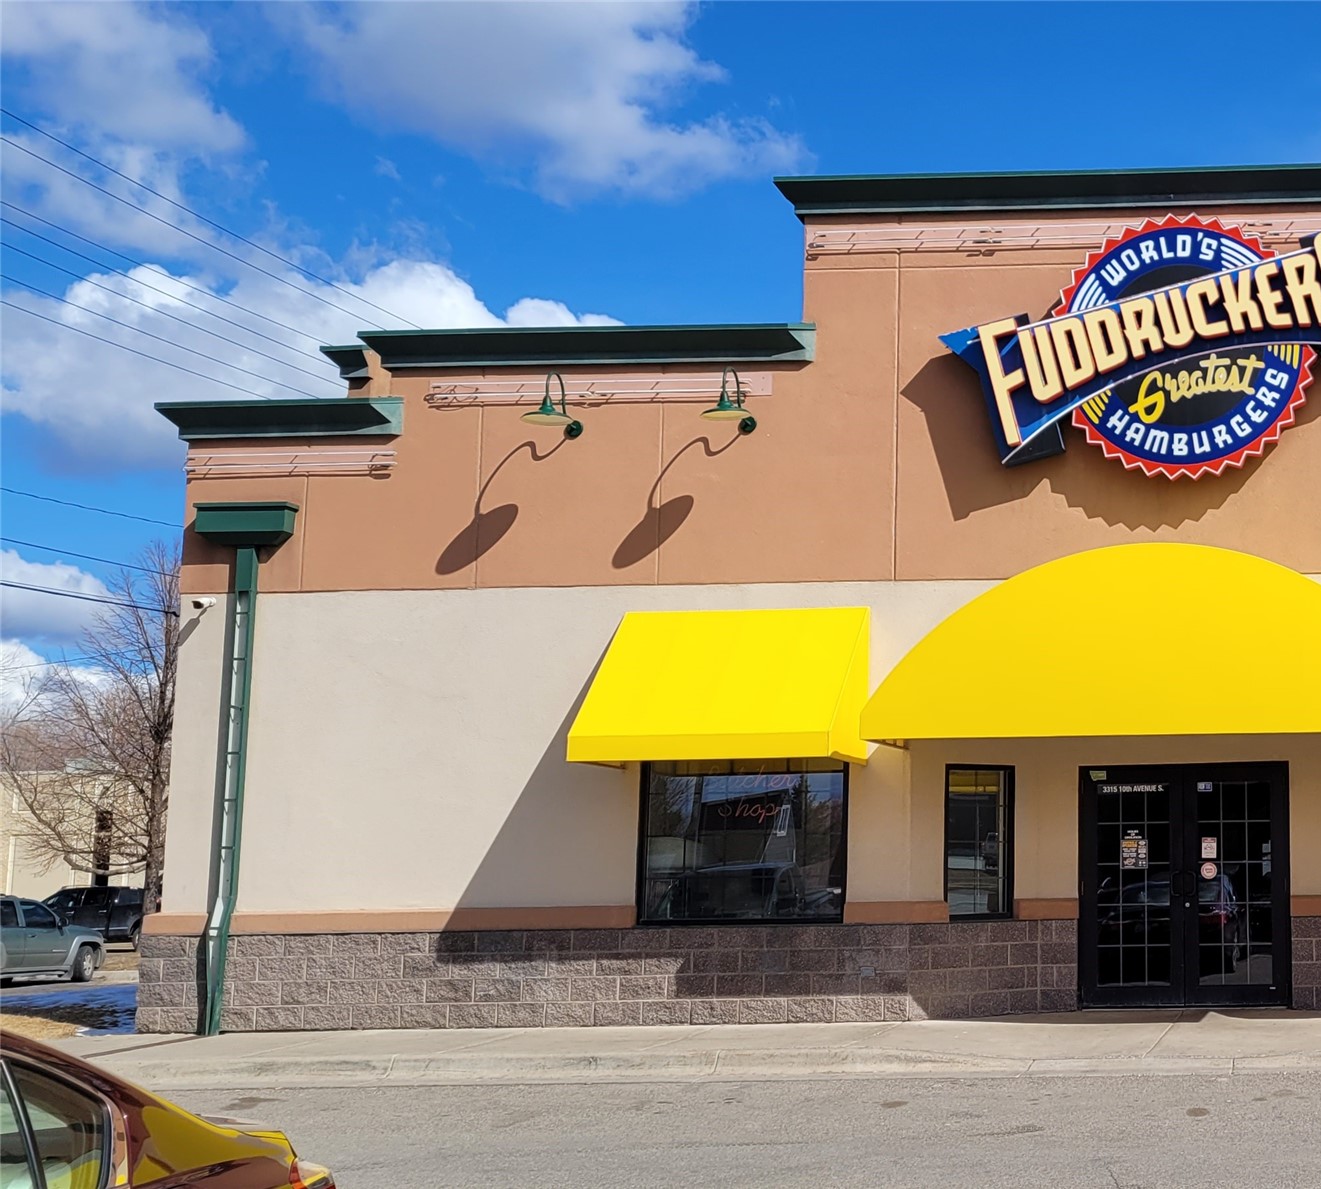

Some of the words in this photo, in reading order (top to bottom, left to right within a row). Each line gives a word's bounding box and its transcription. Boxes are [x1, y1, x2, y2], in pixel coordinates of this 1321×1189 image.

[1101, 232, 1218, 286] WORLD'S
[1106, 368, 1289, 456] HAMBURGERS
[1129, 353, 1266, 424] Greatest
[704, 764, 800, 788] Btcher
[1133, 784, 1157, 792] AVENUE
